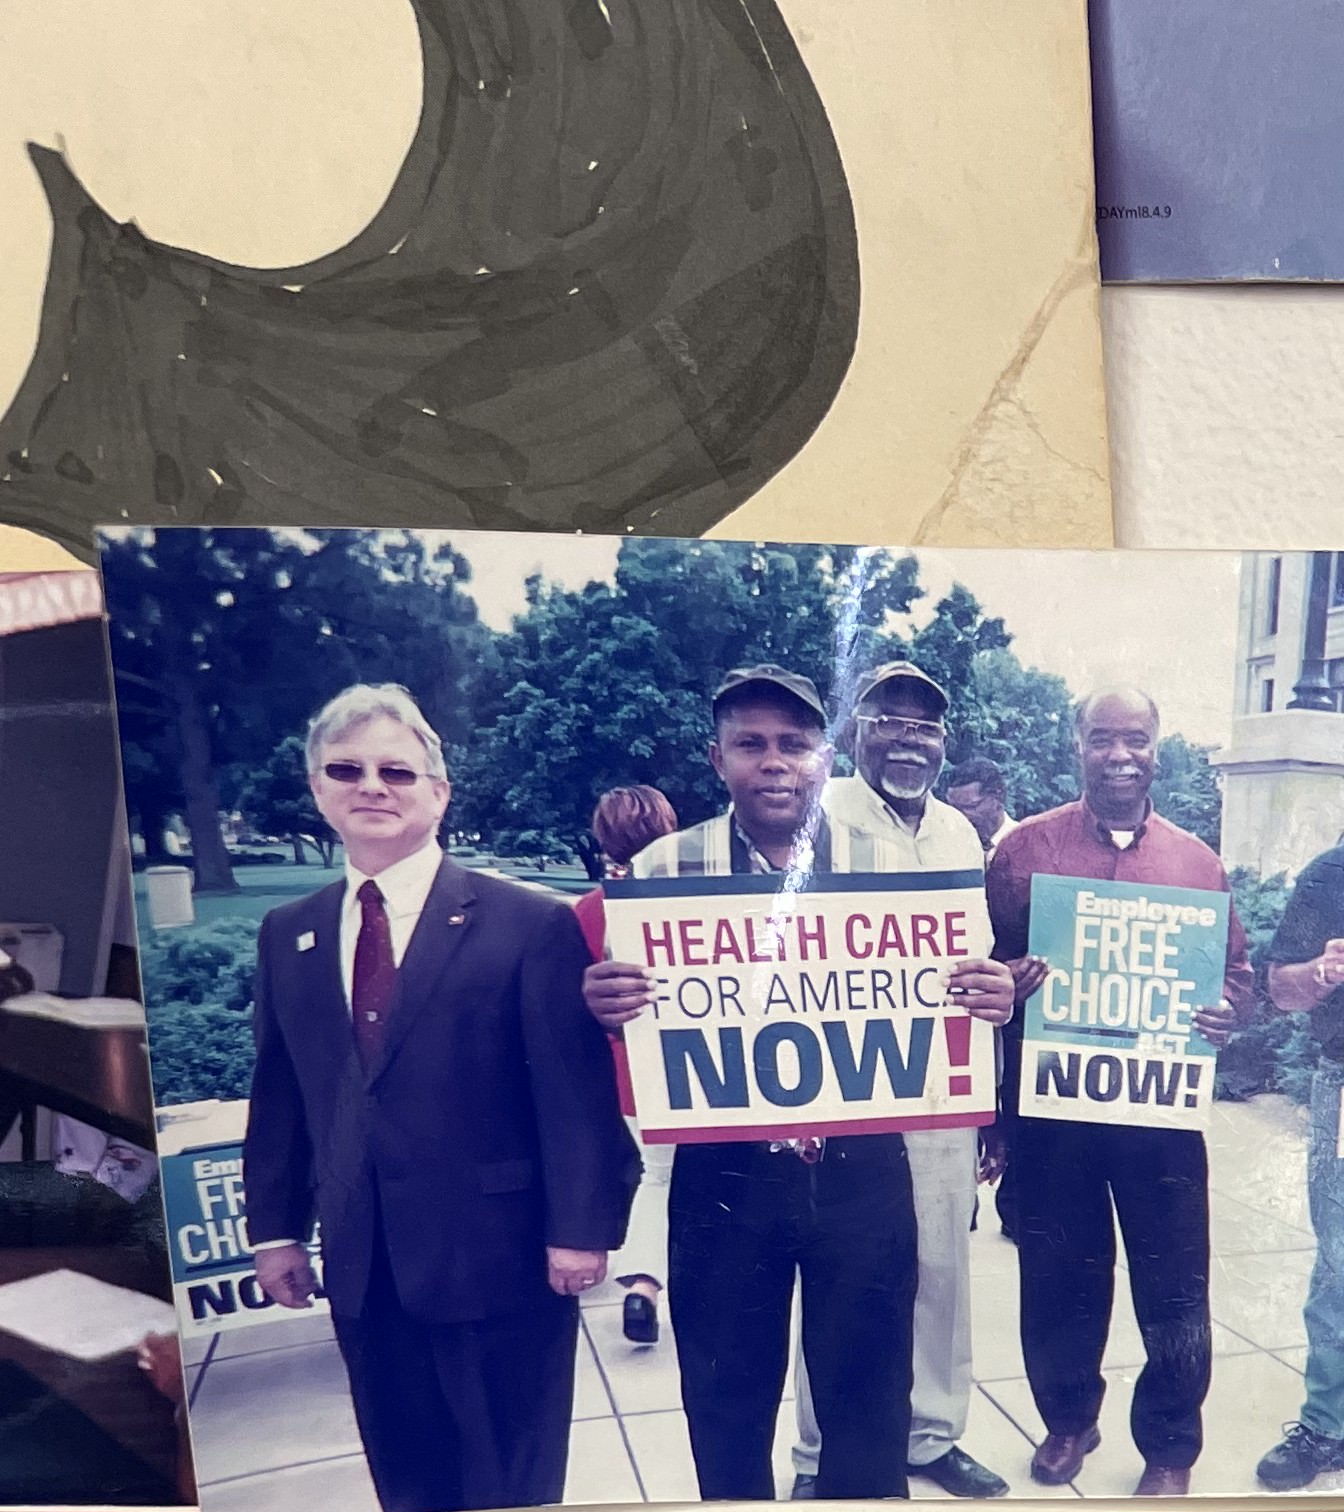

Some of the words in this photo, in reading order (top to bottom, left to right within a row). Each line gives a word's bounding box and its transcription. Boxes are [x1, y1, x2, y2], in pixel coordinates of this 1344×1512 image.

[1076, 890, 1217, 928] Employee
[641, 914, 828, 968] HEALTH
[844, 911, 970, 960] CARE
[1073, 915, 1182, 979] FREE
[652, 973, 746, 1020] FOR
[763, 966, 950, 1015] AMERIC
[1042, 967, 1196, 1034] CHOICE
[659, 1015, 973, 1111] NOW!
[1135, 1032, 1191, 1056] ACT
[1034, 1050, 1203, 1109] NOW!
